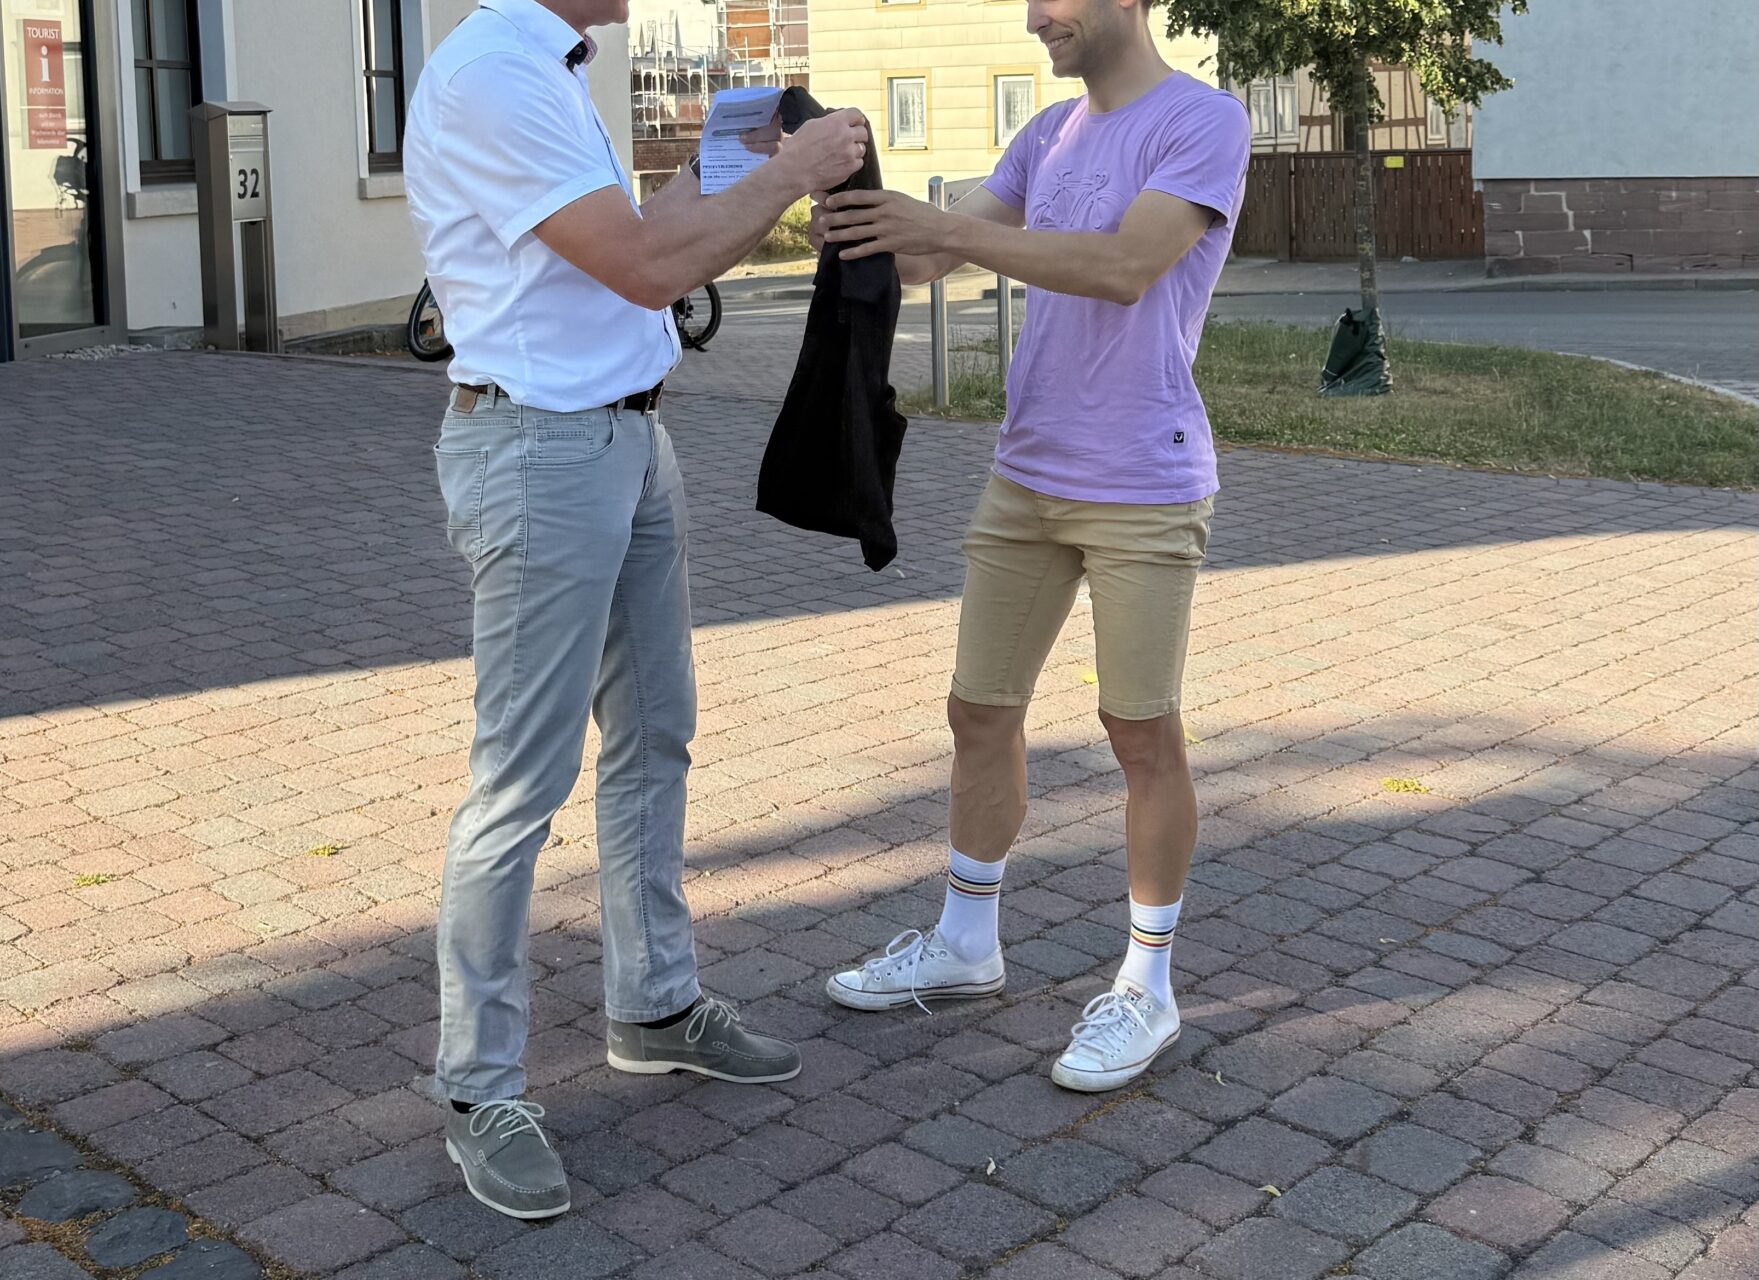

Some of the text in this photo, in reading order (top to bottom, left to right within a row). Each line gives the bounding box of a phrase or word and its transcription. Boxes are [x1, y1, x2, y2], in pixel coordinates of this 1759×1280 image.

[27, 27, 60, 39] TOURIST
[29, 87, 64, 95] INFORMATION
[237, 168, 260, 199] 32
